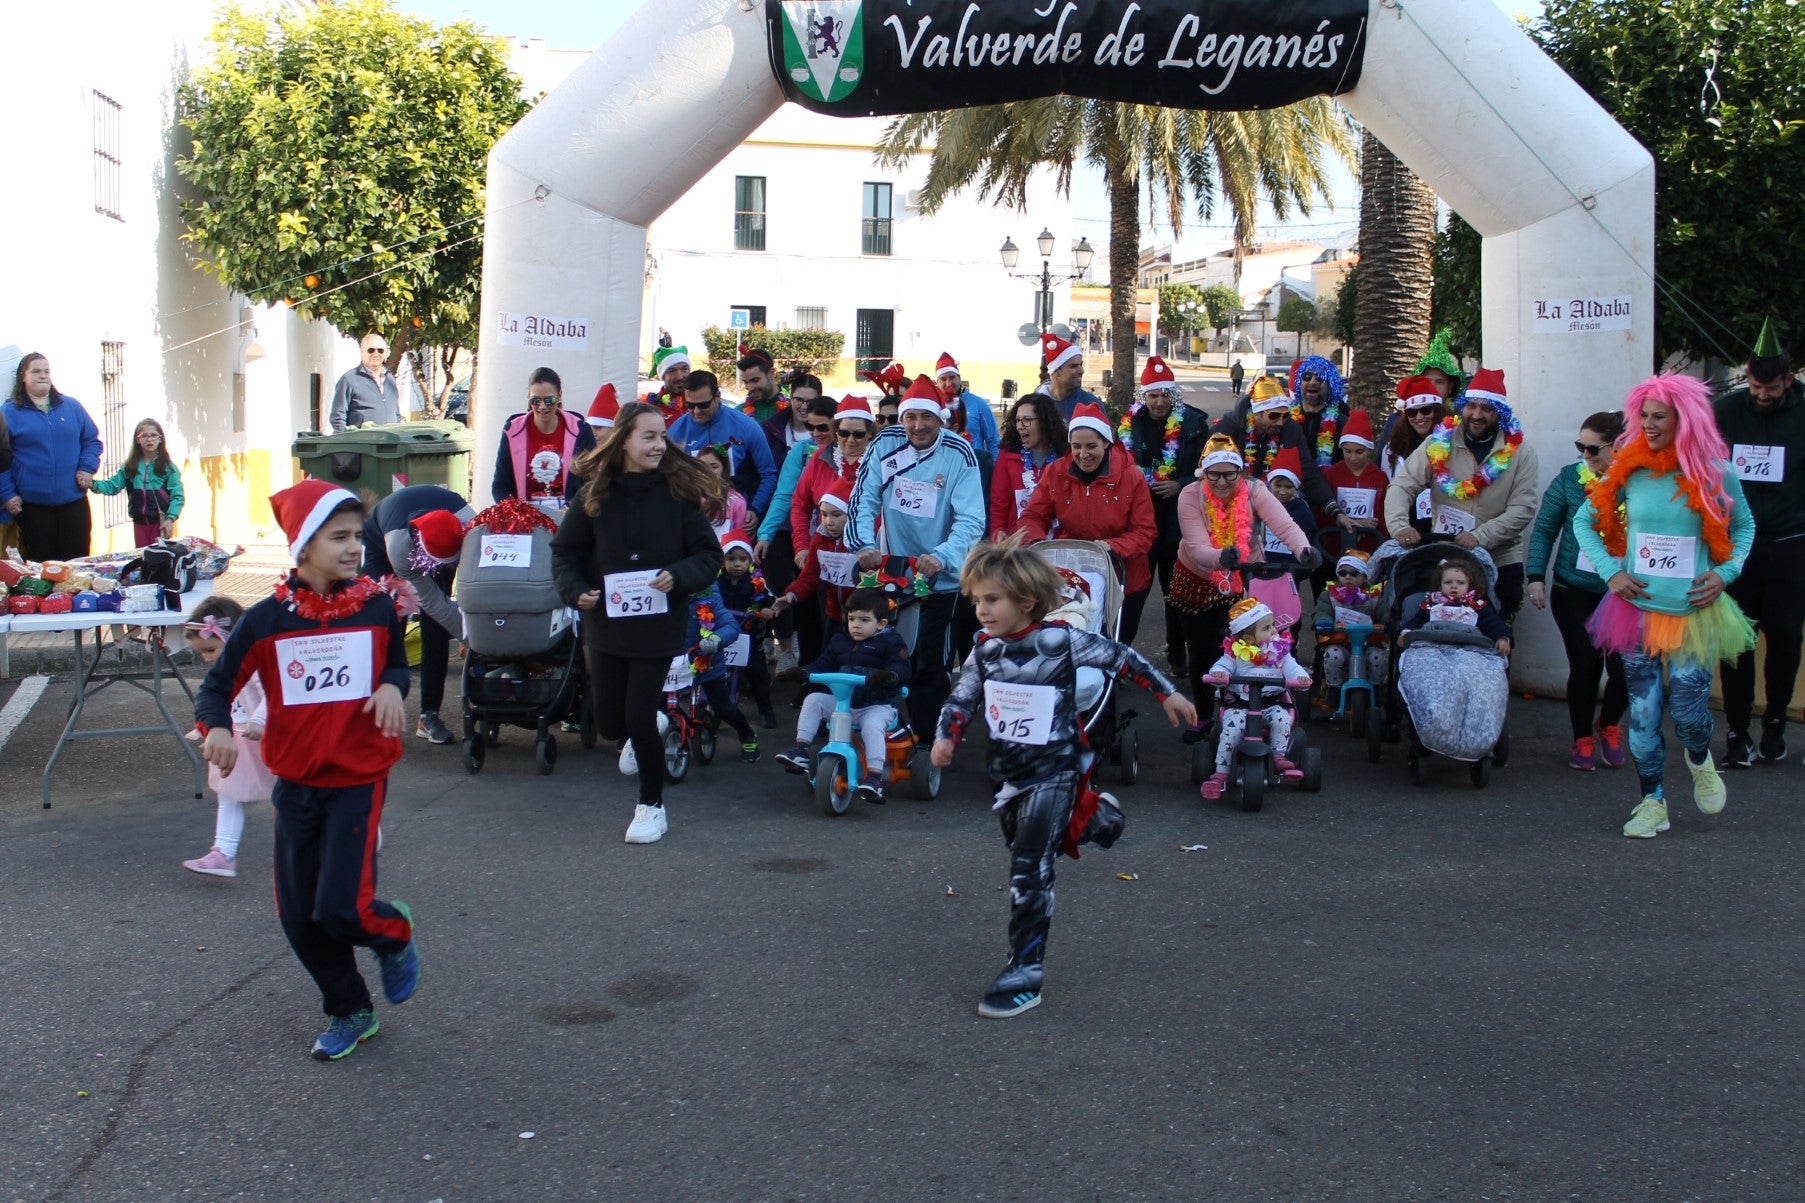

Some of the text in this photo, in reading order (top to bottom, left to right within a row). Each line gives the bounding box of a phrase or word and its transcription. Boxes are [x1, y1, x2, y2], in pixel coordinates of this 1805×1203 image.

[883, 2, 1345, 96] Valverde de Leganés
[1534, 299, 1630, 319] La Aldaba
[499, 312, 586, 338] La Aldaba
[1744, 462, 1771, 475] 018
[900, 498, 923, 509] 005
[1346, 505, 1367, 516] 010
[1649, 556, 1677, 569] 016
[622, 596, 652, 612] 039
[305, 665, 350, 692] 026
[998, 718, 1035, 737] 015
